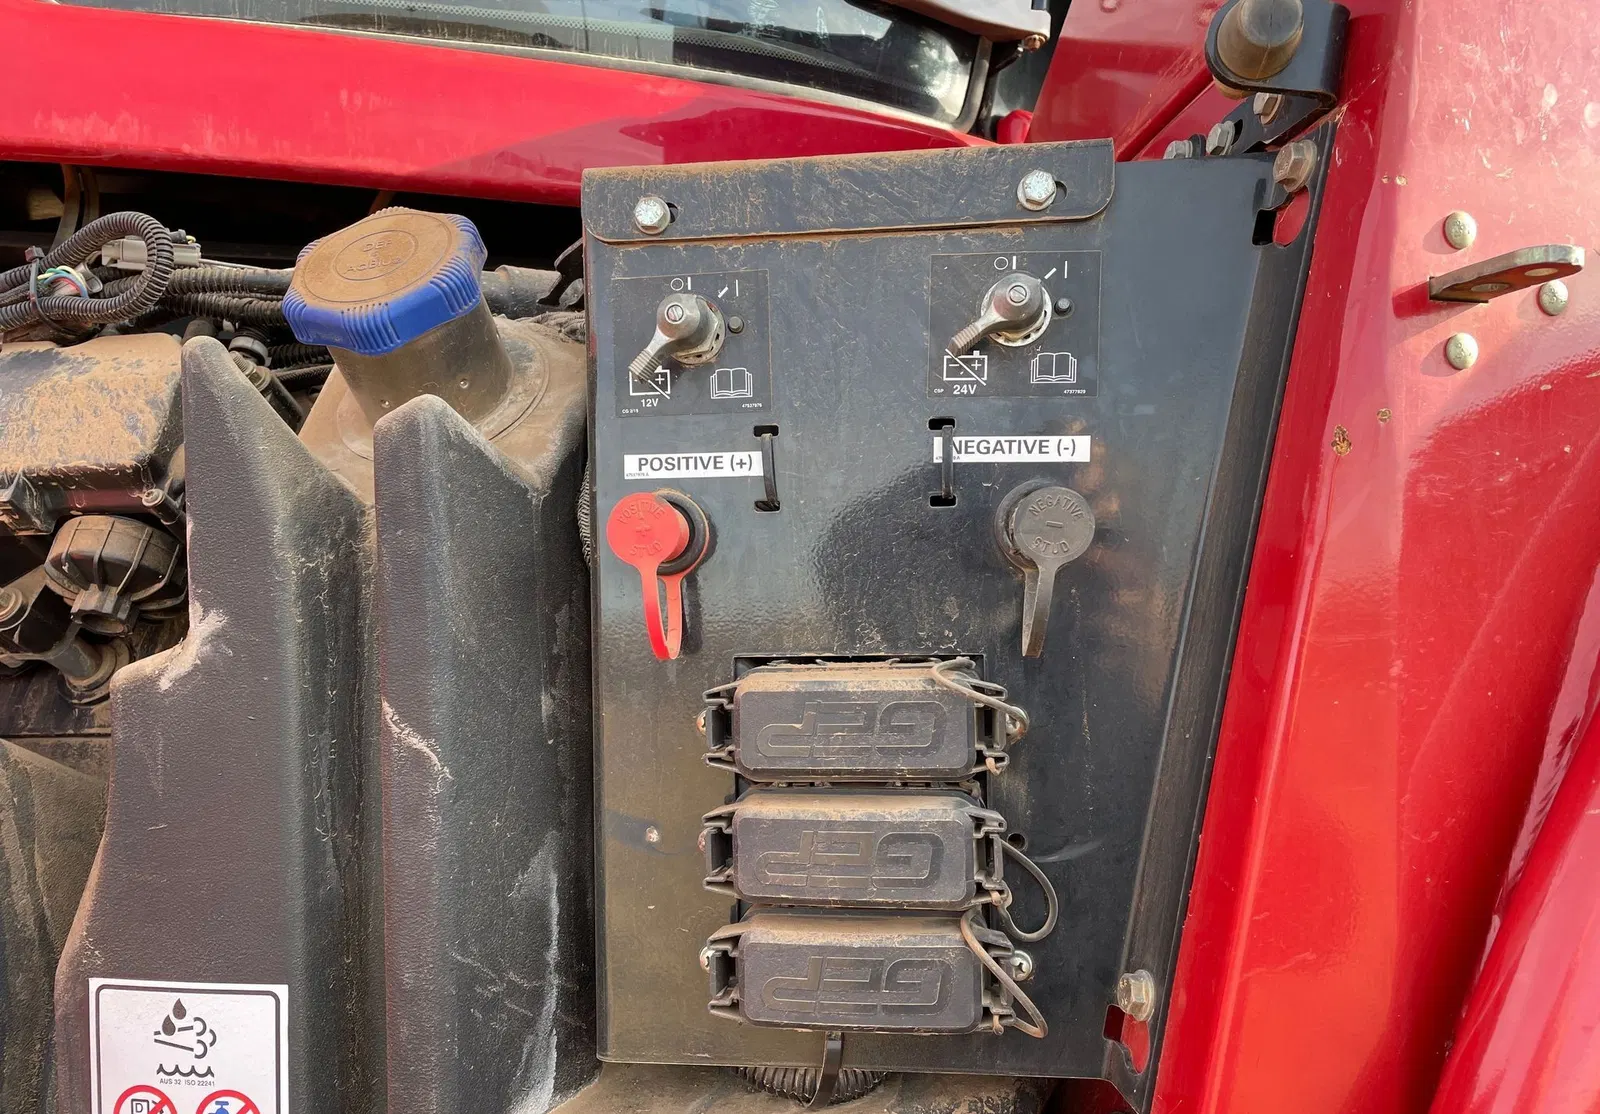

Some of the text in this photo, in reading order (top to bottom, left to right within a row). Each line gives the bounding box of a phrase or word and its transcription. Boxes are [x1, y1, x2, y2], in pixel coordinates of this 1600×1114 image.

[953, 384, 977, 395] 24V
[640, 398, 659, 408] 12V
[952, 438, 1076, 457] NEGATIVE (-)
[638, 454, 753, 472] POSITIVE (+)
[616, 499, 667, 525] POSITIVE
[1028, 494, 1085, 520] NEGATIVE
[630, 540, 663, 558] STUD
[1031, 536, 1070, 554] STUD
